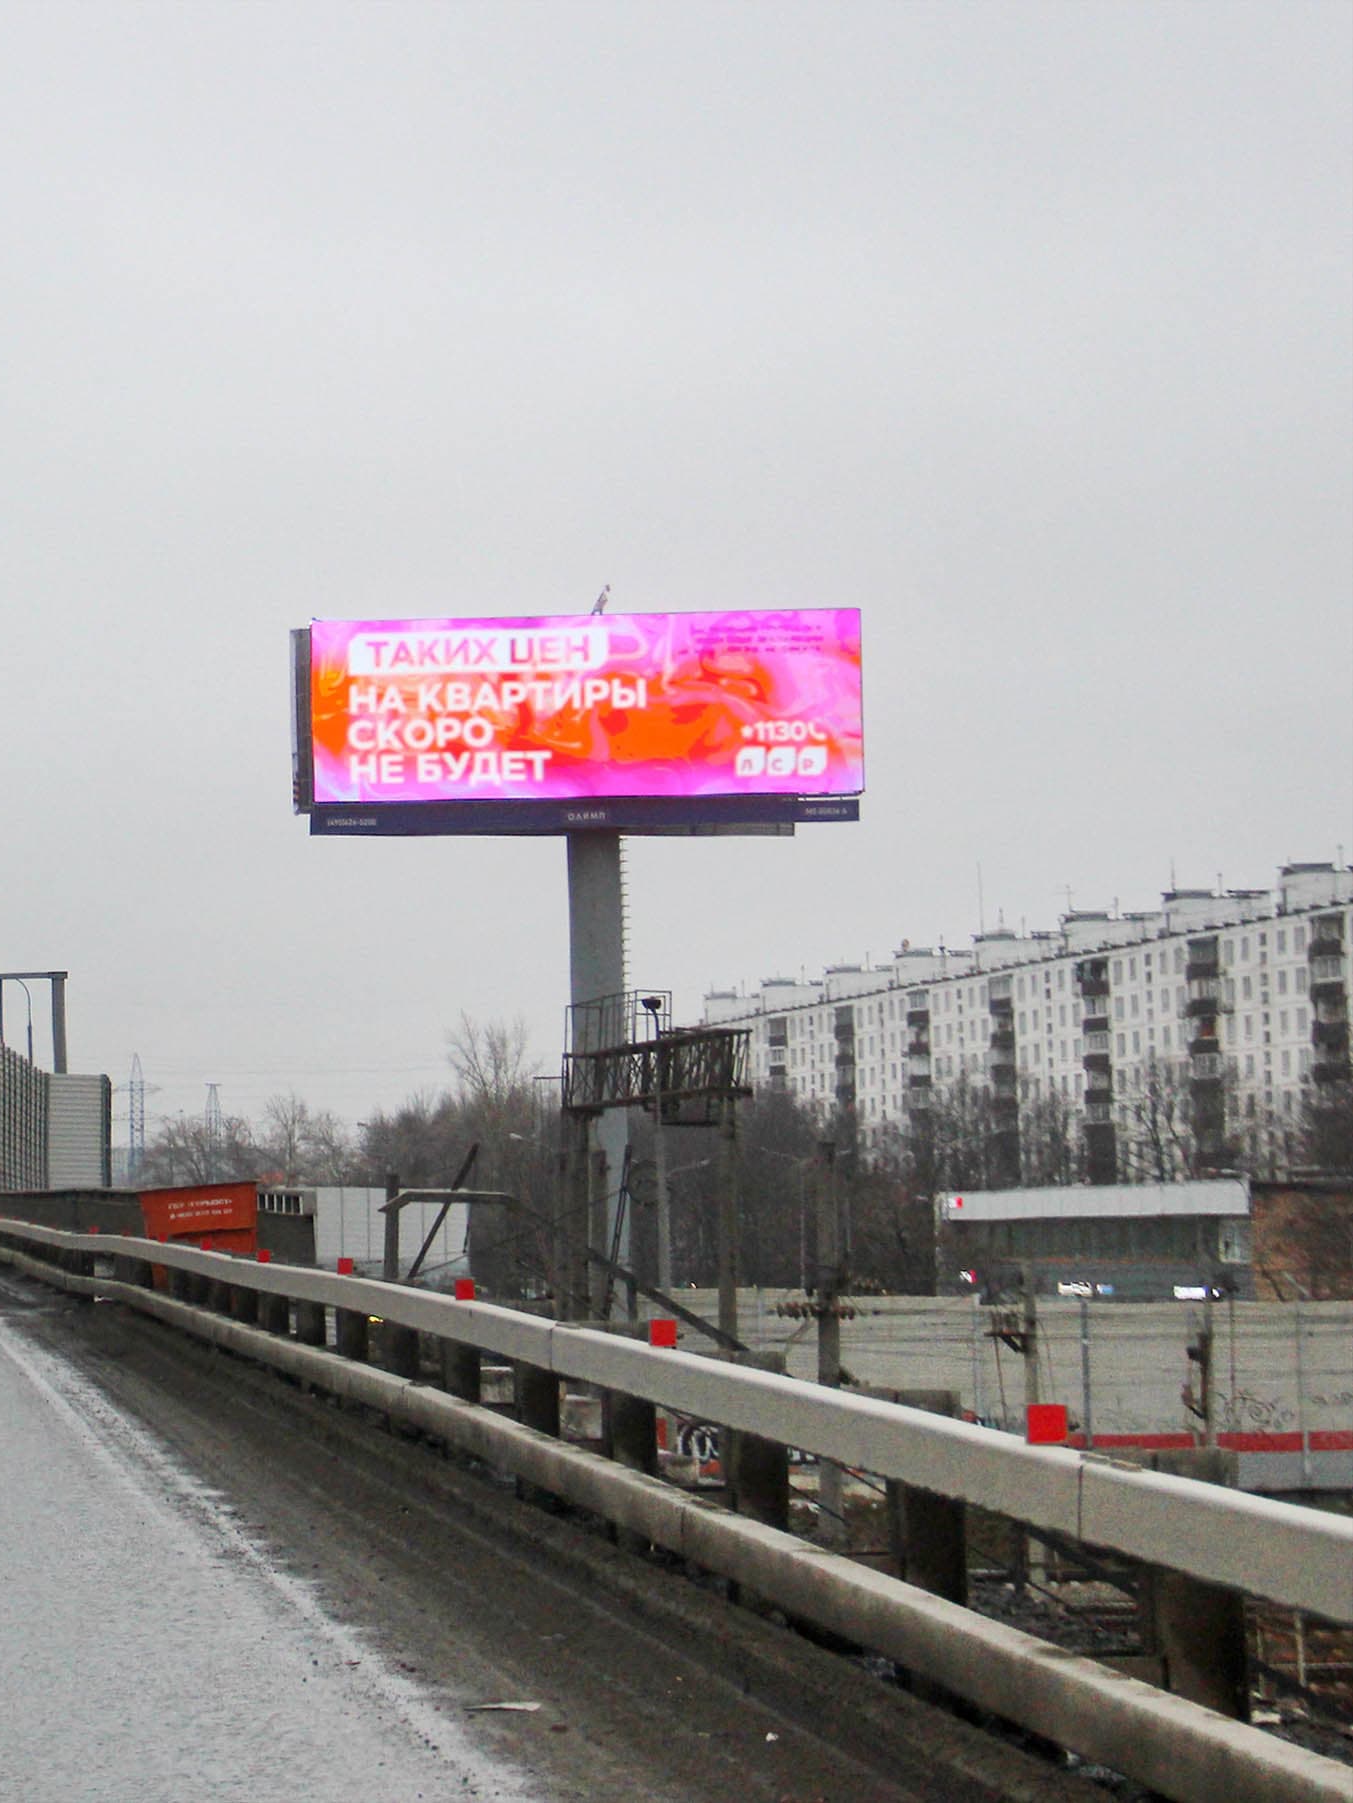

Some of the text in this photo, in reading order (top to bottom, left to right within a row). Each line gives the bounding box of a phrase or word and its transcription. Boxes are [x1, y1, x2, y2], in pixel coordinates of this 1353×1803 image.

[365, 634, 590, 668] ТАКИХ ЦЕН
[349, 678, 646, 714] НА КВАРТИРЫ
[348, 716, 494, 750] СКОРО
[349, 751, 552, 787] НЕ БУДЕТ
